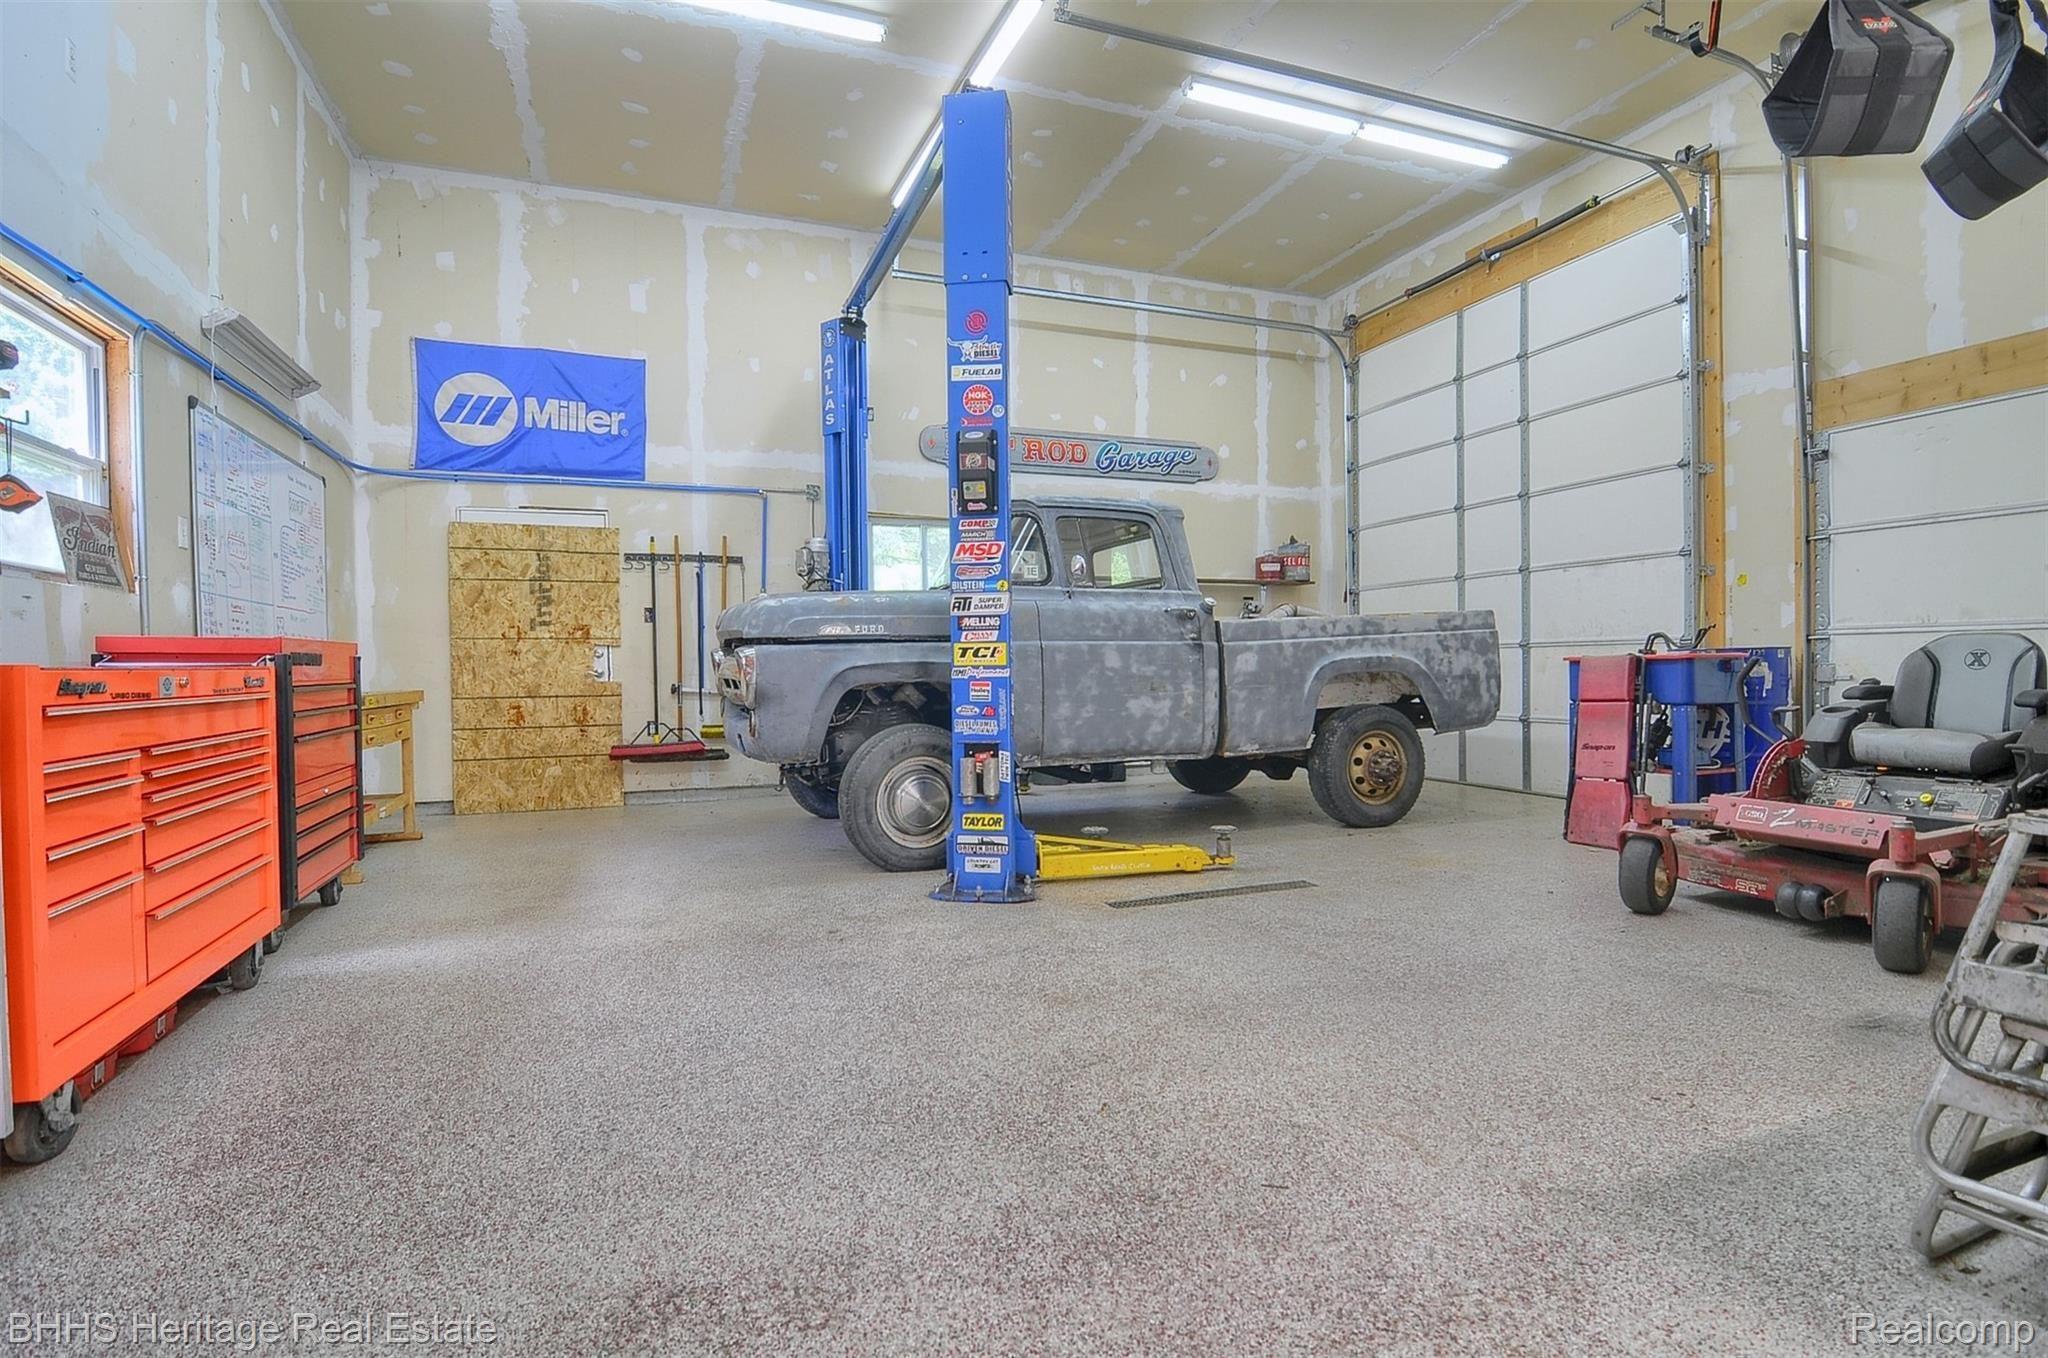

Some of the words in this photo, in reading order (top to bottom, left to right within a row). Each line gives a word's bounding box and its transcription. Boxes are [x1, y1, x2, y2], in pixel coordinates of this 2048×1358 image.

[962, 368, 1001, 376] FUELAB
[824, 353, 835, 425] ATLAS
[523, 396, 626, 436] Miller
[1023, 437, 1089, 465] ROD
[1095, 440, 1197, 475] Garage
[62, 526, 116, 558] Indian
[955, 543, 1002, 557] MSD
[951, 580, 985, 590] BILSTEIN
[962, 616, 1000, 627] MELLING
[963, 816, 1003, 828] TAYLOR
[1795, 819, 1880, 839] MASTER
